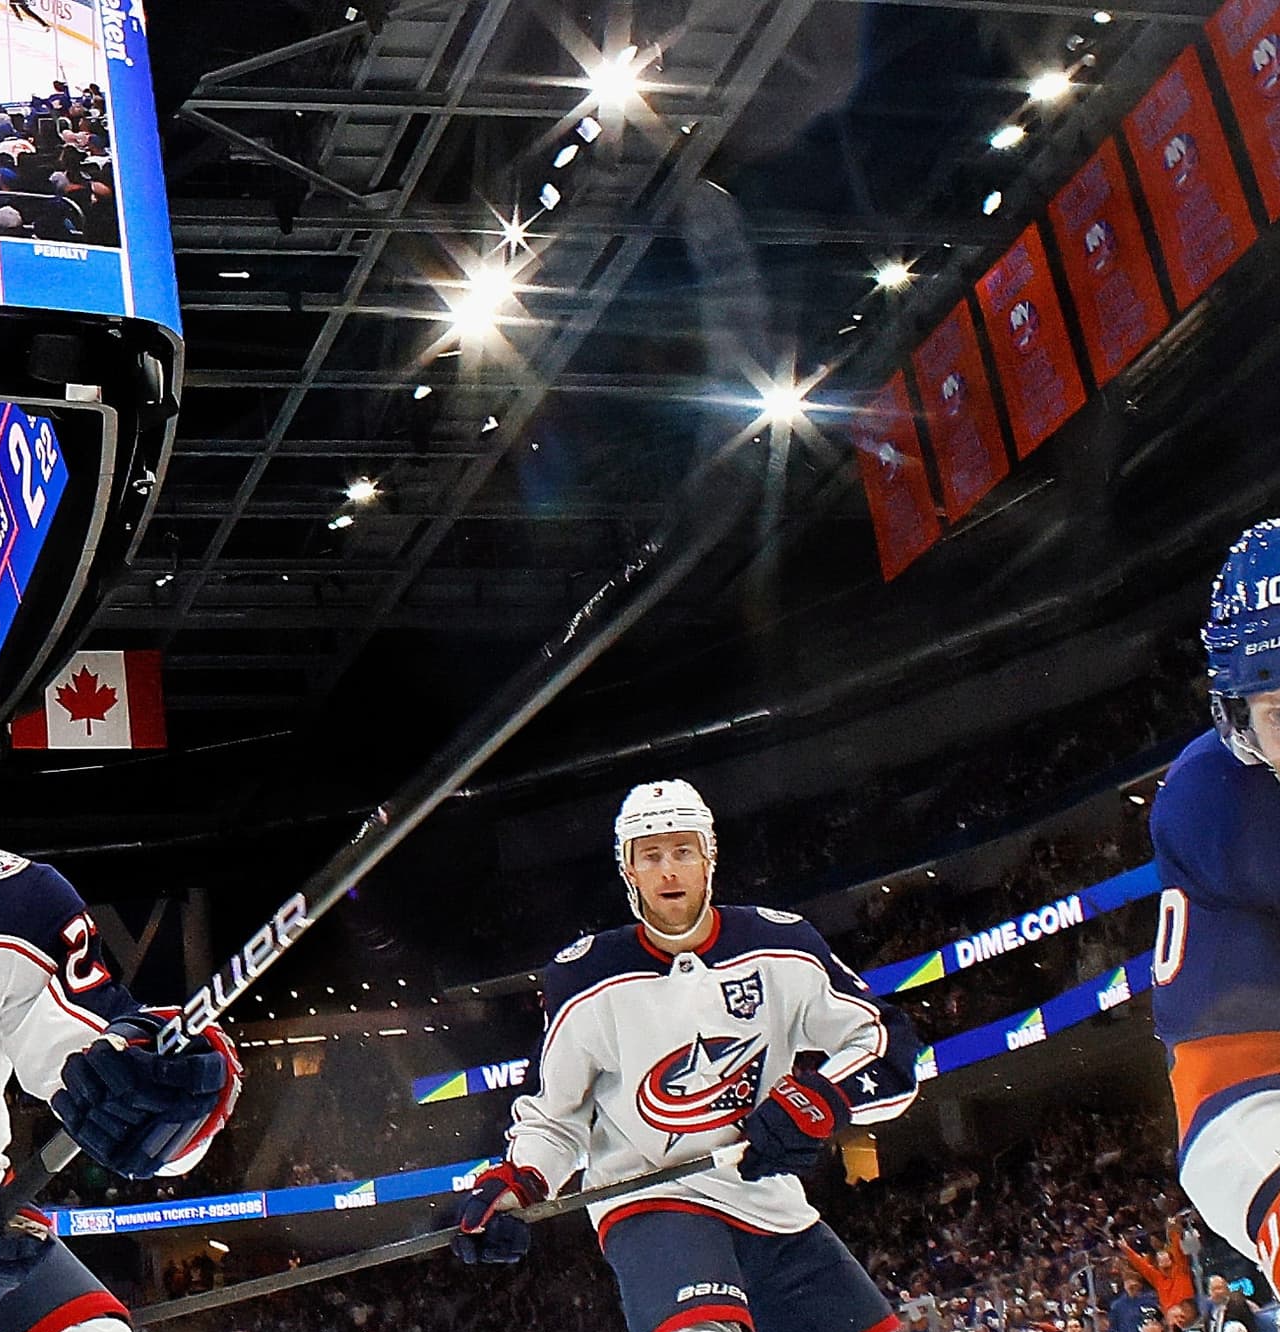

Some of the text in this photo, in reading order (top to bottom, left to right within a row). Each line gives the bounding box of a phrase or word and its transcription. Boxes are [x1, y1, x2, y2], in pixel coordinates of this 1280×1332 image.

[34, 244, 89, 260] PENALTY
[9, 422, 45, 528] 2
[653, 788, 663, 797] 3
[954, 896, 1084, 970] DIME.COM
[1154, 888, 1188, 985] 0
[60, 911, 112, 993] 2
[1099, 984, 1131, 1011] DIME
[1007, 1023, 1046, 1052] DIME
[483, 1058, 529, 1090] WE'
[772, 1080, 825, 1124] UER
[452, 1174, 477, 1193] DI
[334, 1193, 376, 1210] DIME
[116, 1210, 161, 1226] WINNING
